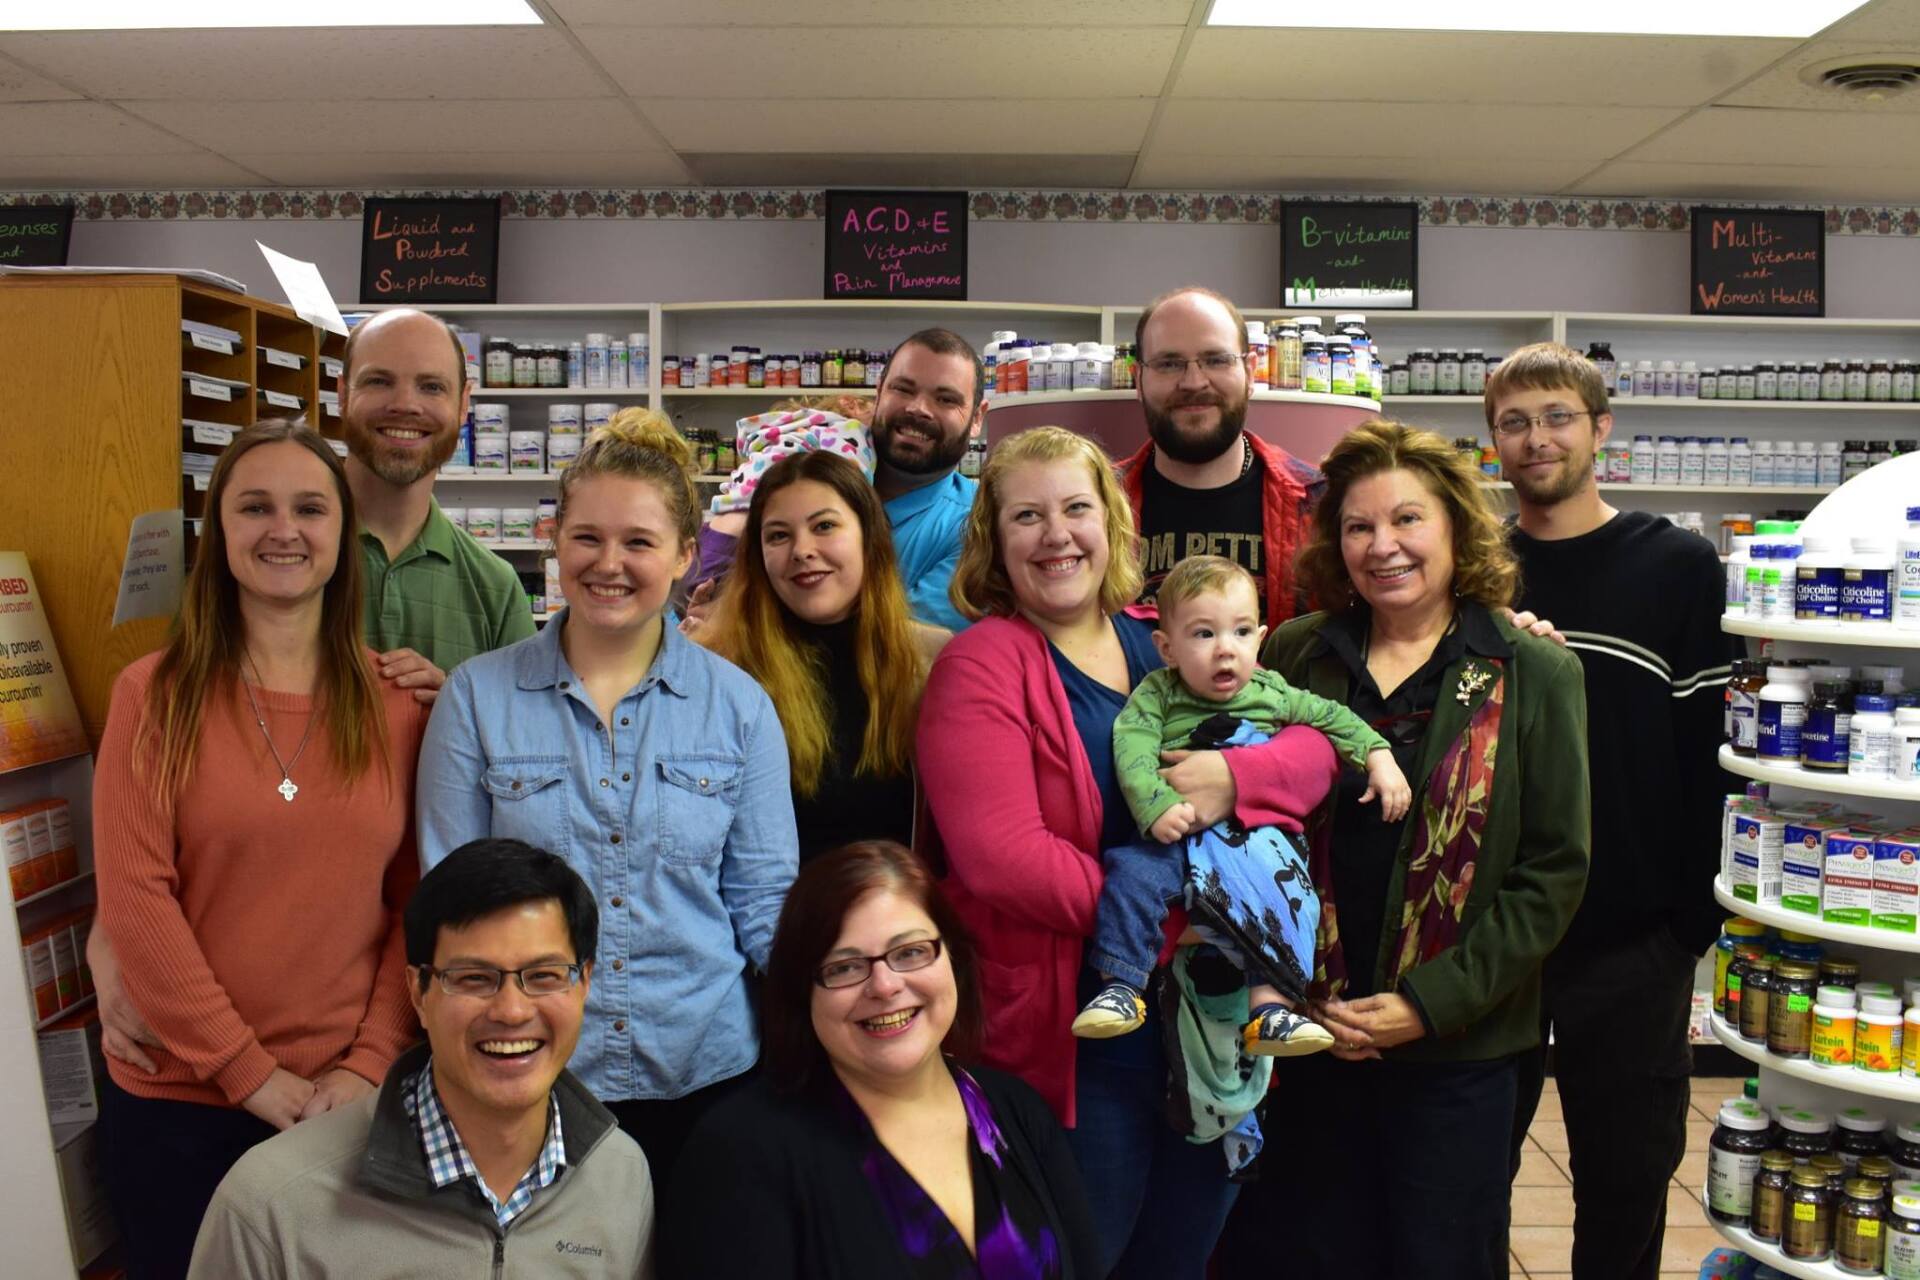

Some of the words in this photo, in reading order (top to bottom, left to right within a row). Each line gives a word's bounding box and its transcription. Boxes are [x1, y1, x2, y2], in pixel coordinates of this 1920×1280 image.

[374, 209, 441, 241] Liquid
[450, 222, 476, 235] and
[1711, 219, 1783, 250] Multi-
[880, 260, 903, 272] and
[375, 267, 488, 293] Supplements
[833, 272, 878, 293] Pain
[1698, 282, 1767, 311] Women's
[1771, 287, 1819, 305] Health
[1797, 584, 1838, 595] Citicoline
[1843, 586, 1885, 597] Citicoline
[1810, 594, 1838, 602] Choline
[1856, 596, 1884, 605] Choline
[10, 640, 44, 658] proven
[1814, 1032, 1844, 1047] Lutein
